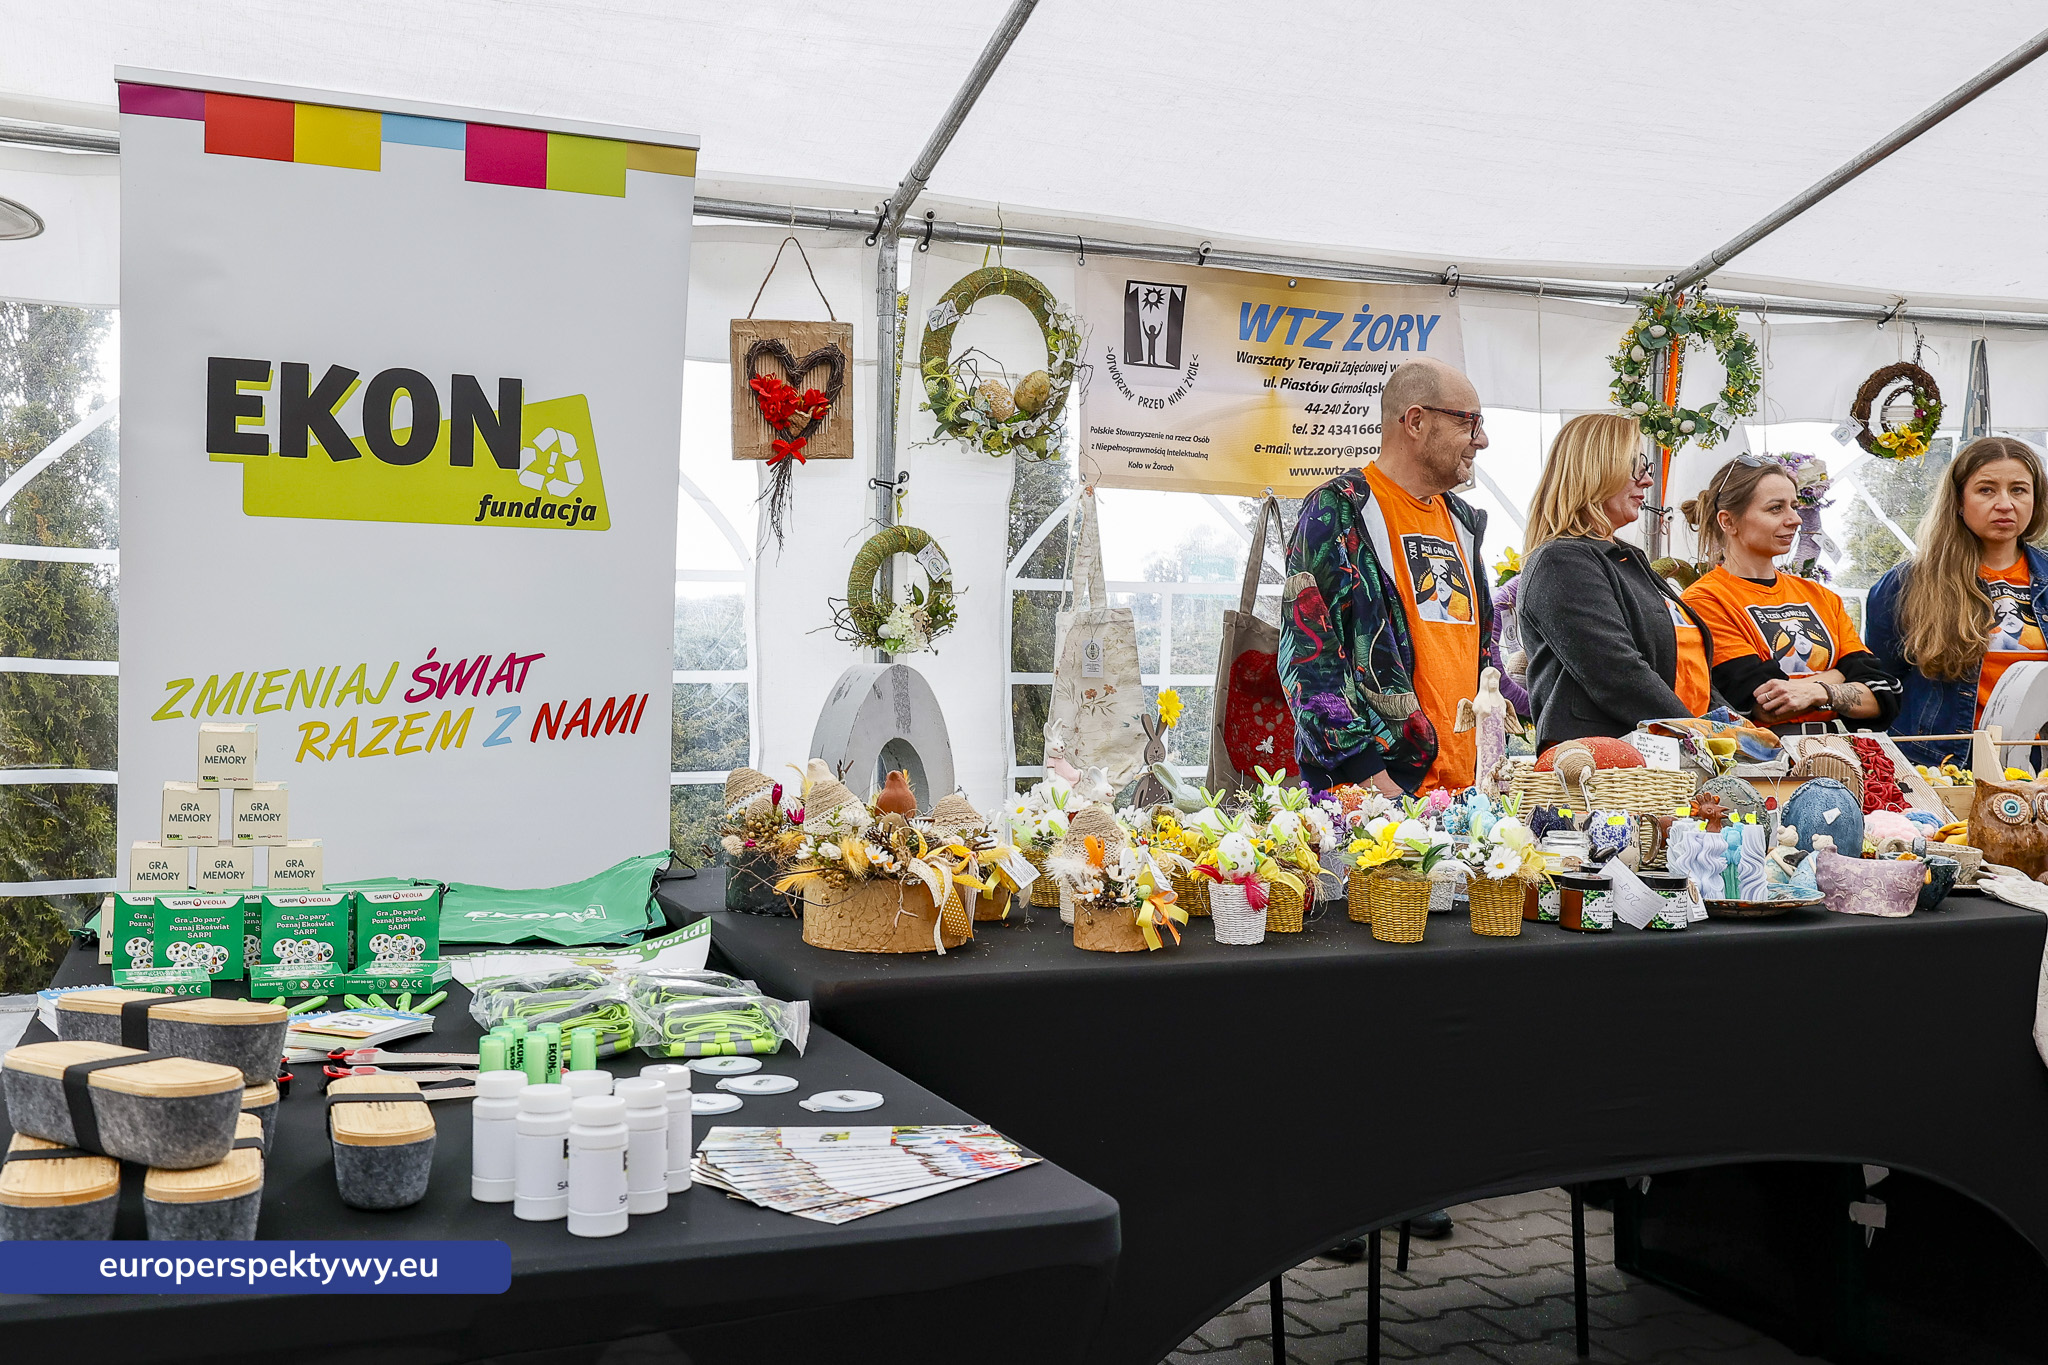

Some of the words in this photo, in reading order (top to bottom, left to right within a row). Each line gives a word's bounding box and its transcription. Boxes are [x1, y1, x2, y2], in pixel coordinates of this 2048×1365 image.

[1239, 302, 1344, 350] WTZ
[1342, 303, 1441, 352] ŻORY
[1236, 351, 1295, 370] Warsztaty
[1298, 357, 1340, 375] Terapii
[1340, 361, 1388, 376] Zajęciowej
[1263, 376, 1277, 388] ul.
[1280, 377, 1328, 394] Piastów
[1138, 395, 1165, 409] PRZED
[1167, 386, 1188, 406] NIMI
[206, 356, 523, 470] EKON
[1304, 403, 1341, 415] 44-240
[1342, 401, 1370, 417] Żory
[1292, 423, 1308, 435] tel.
[1311, 424, 1325, 435] 32
[1328, 424, 1382, 436] 4341666
[1090, 425, 1114, 435] Polskie
[1115, 427, 1165, 440] Stowarzyszenie
[1165, 433, 1174, 441] na
[1193, 435, 1210, 444] Osób
[1095, 442, 1166, 457] Niepełnosprawnością
[1167, 448, 1209, 460] Intelektualną
[1254, 443, 1292, 455] e-mail:
[1128, 461, 1143, 469] Koło
[1152, 461, 1174, 471] Żorach
[475, 494, 598, 526] fundacja
[151, 660, 400, 721] ZMIENIAJ
[404, 647, 545, 704] ŚWIAT
[295, 707, 475, 764] RAZEM
[482, 705, 521, 747] Z
[530, 693, 649, 742] NAMI
[216, 744, 236, 753] GRA
[204, 755, 247, 764] MEMORY
[180, 803, 200, 811] GRA
[250, 803, 270, 811] GRA
[168, 813, 212, 822] MEMORY
[239, 813, 281, 822] MEMORY
[148, 861, 168, 869] GRA
[214, 860, 234, 868] GRA
[285, 859, 305, 867] GRA
[136, 872, 180, 881] MEMORY
[203, 871, 245, 880] MEMORY
[274, 870, 316, 879] MEMORY
[129, 920, 154, 928] Poznaj
[276, 921, 301, 929] Poznaj
[301, 920, 335, 928] Ekoświat
[371, 917, 395, 925] Poznaj
[395, 915, 427, 923] Ekoświat
[169, 924, 195, 932] Poznaj
[196, 923, 230, 931] Ekoświat
[388, 923, 410, 931] SARPI
[293, 928, 317, 936] SARPI
[646, 922, 707, 951] World!
[548, 1043, 557, 1069] EKON
